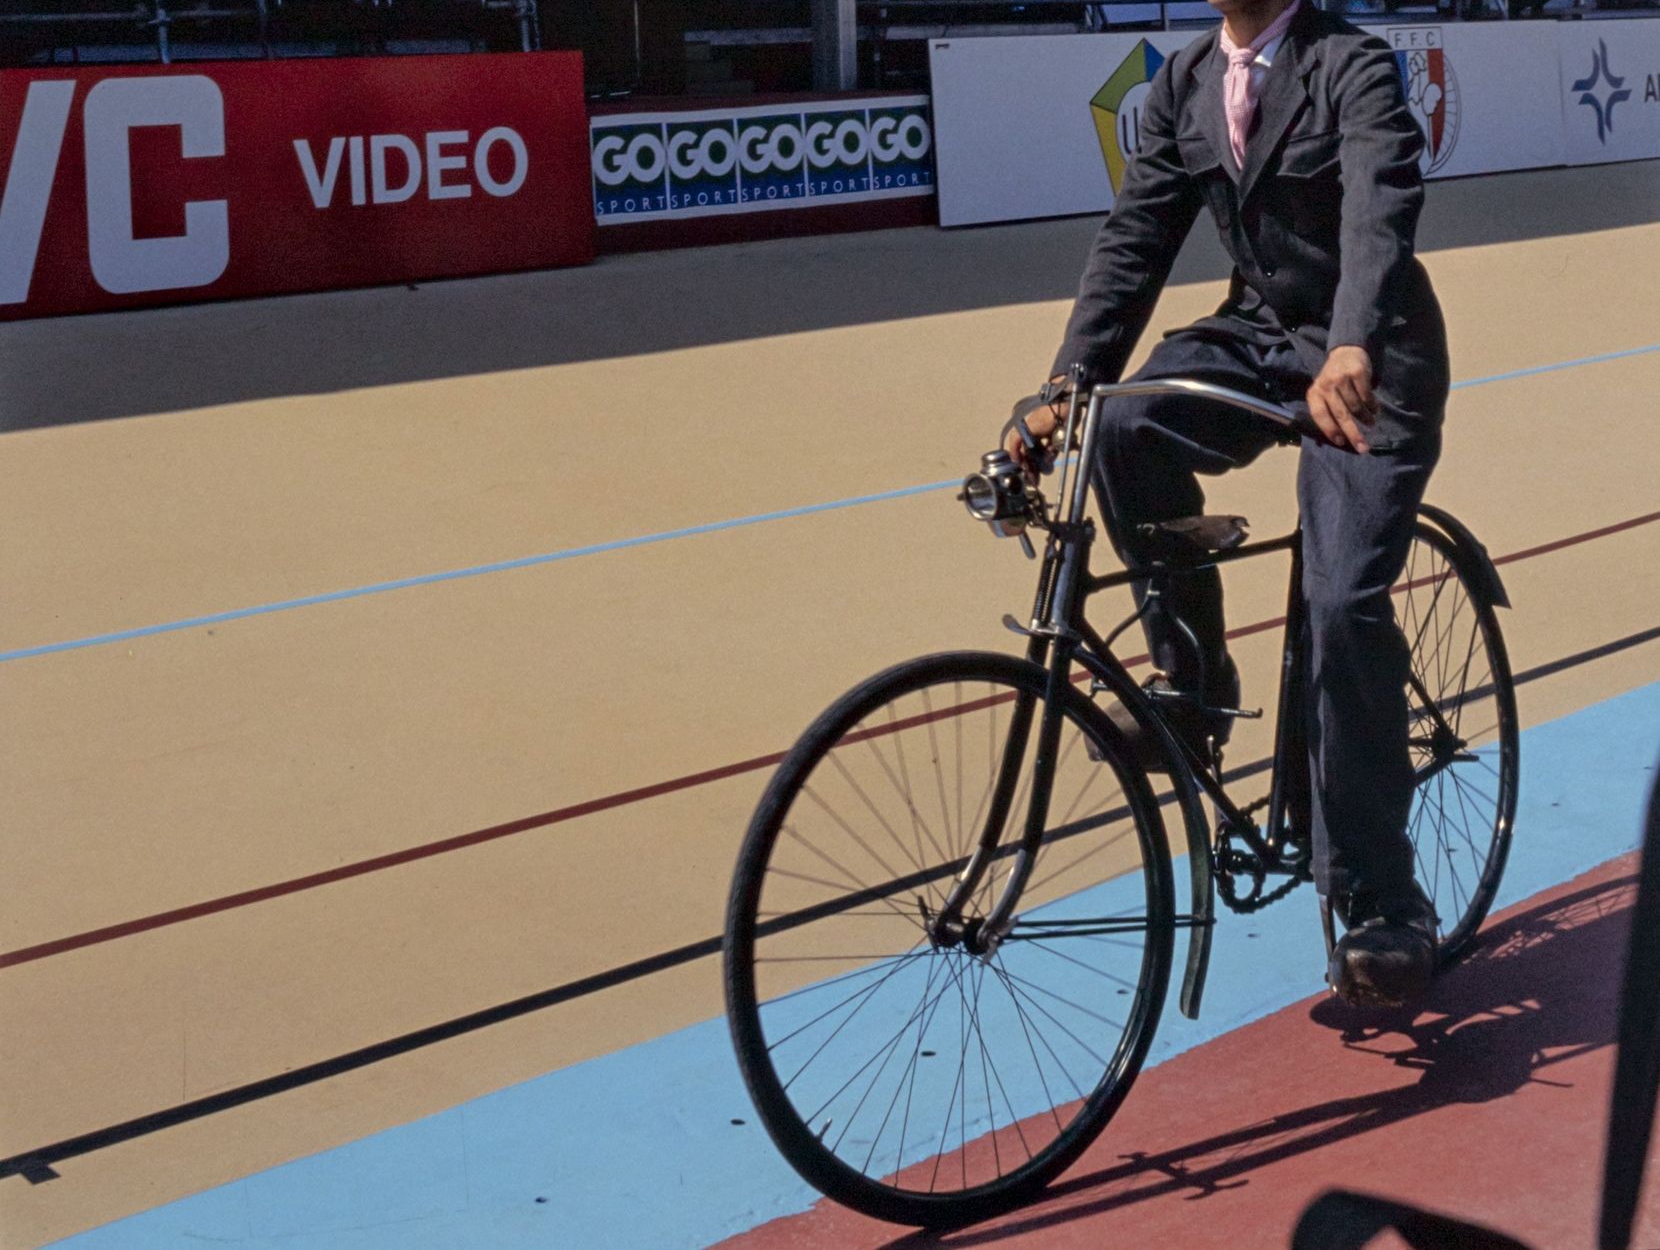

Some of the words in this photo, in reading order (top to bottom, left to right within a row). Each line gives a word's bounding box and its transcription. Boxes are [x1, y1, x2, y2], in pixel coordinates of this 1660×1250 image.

[1644, 72, 1660, 103] A
[293, 126, 529, 209] VIDEO
[593, 133, 667, 185] GO
[667, 128, 737, 180] GO
[737, 123, 805, 174] GO
[805, 119, 870, 168] GO
[870, 114, 931, 163] GO
[596, 195, 666, 215] SPORT
[670, 189, 737, 209] SPORT
[741, 182, 805, 202] SPORT
[809, 176, 870, 196] SPORT
[874, 171, 931, 189] SPORT
